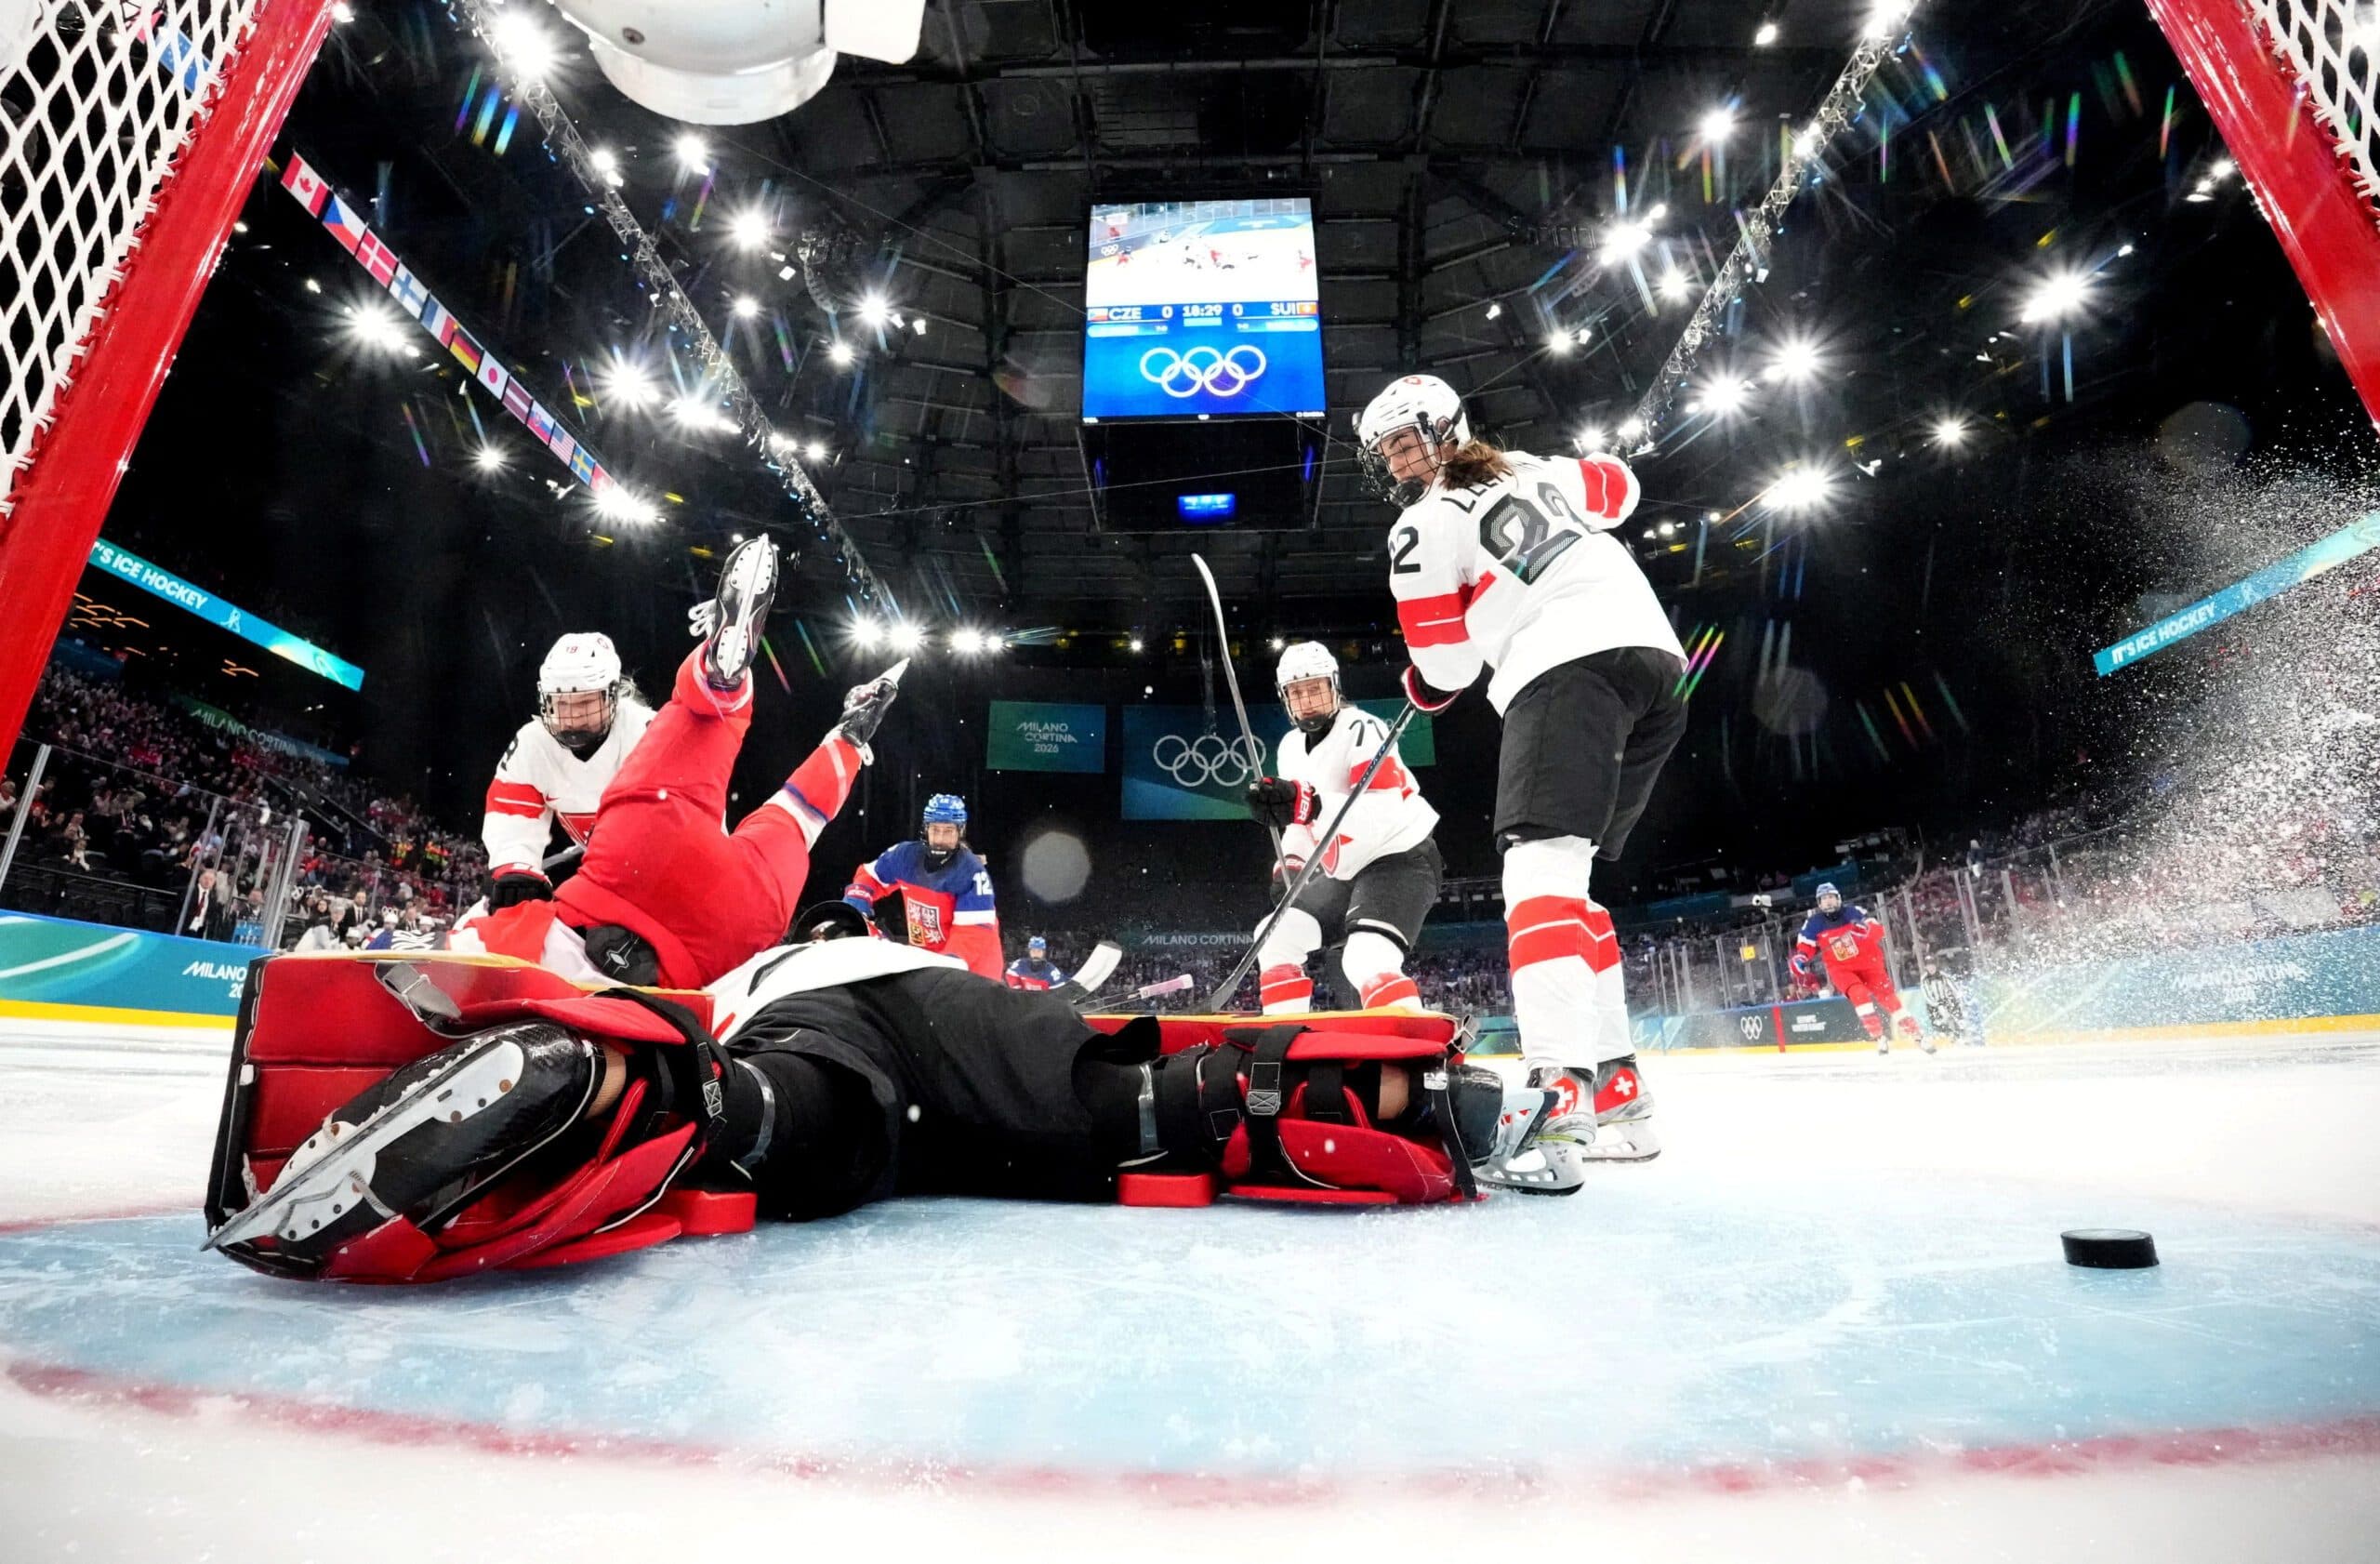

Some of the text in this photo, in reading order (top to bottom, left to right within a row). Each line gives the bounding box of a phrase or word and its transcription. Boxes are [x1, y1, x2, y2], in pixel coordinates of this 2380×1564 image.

[1108, 307, 1142, 320] CZE
[1161, 306, 1173, 319] 0
[1232, 303, 1243, 316] 0
[1270, 302, 1298, 315] SUI
[1389, 526, 1421, 575] 2
[112, 554, 143, 578] ICE
[141, 568, 208, 610] HOCKEY
[2111, 602, 2215, 665] IT'S ICE HOCKEY
[189, 709, 298, 756] MILANO CORTINA
[1016, 722, 1068, 733] MILANO
[1025, 732, 1078, 743] CORTINA
[1034, 743, 1059, 753] 2026
[972, 870, 993, 895] 12
[1142, 934, 1197, 946] MILANO
[182, 961, 247, 982] MILANO
